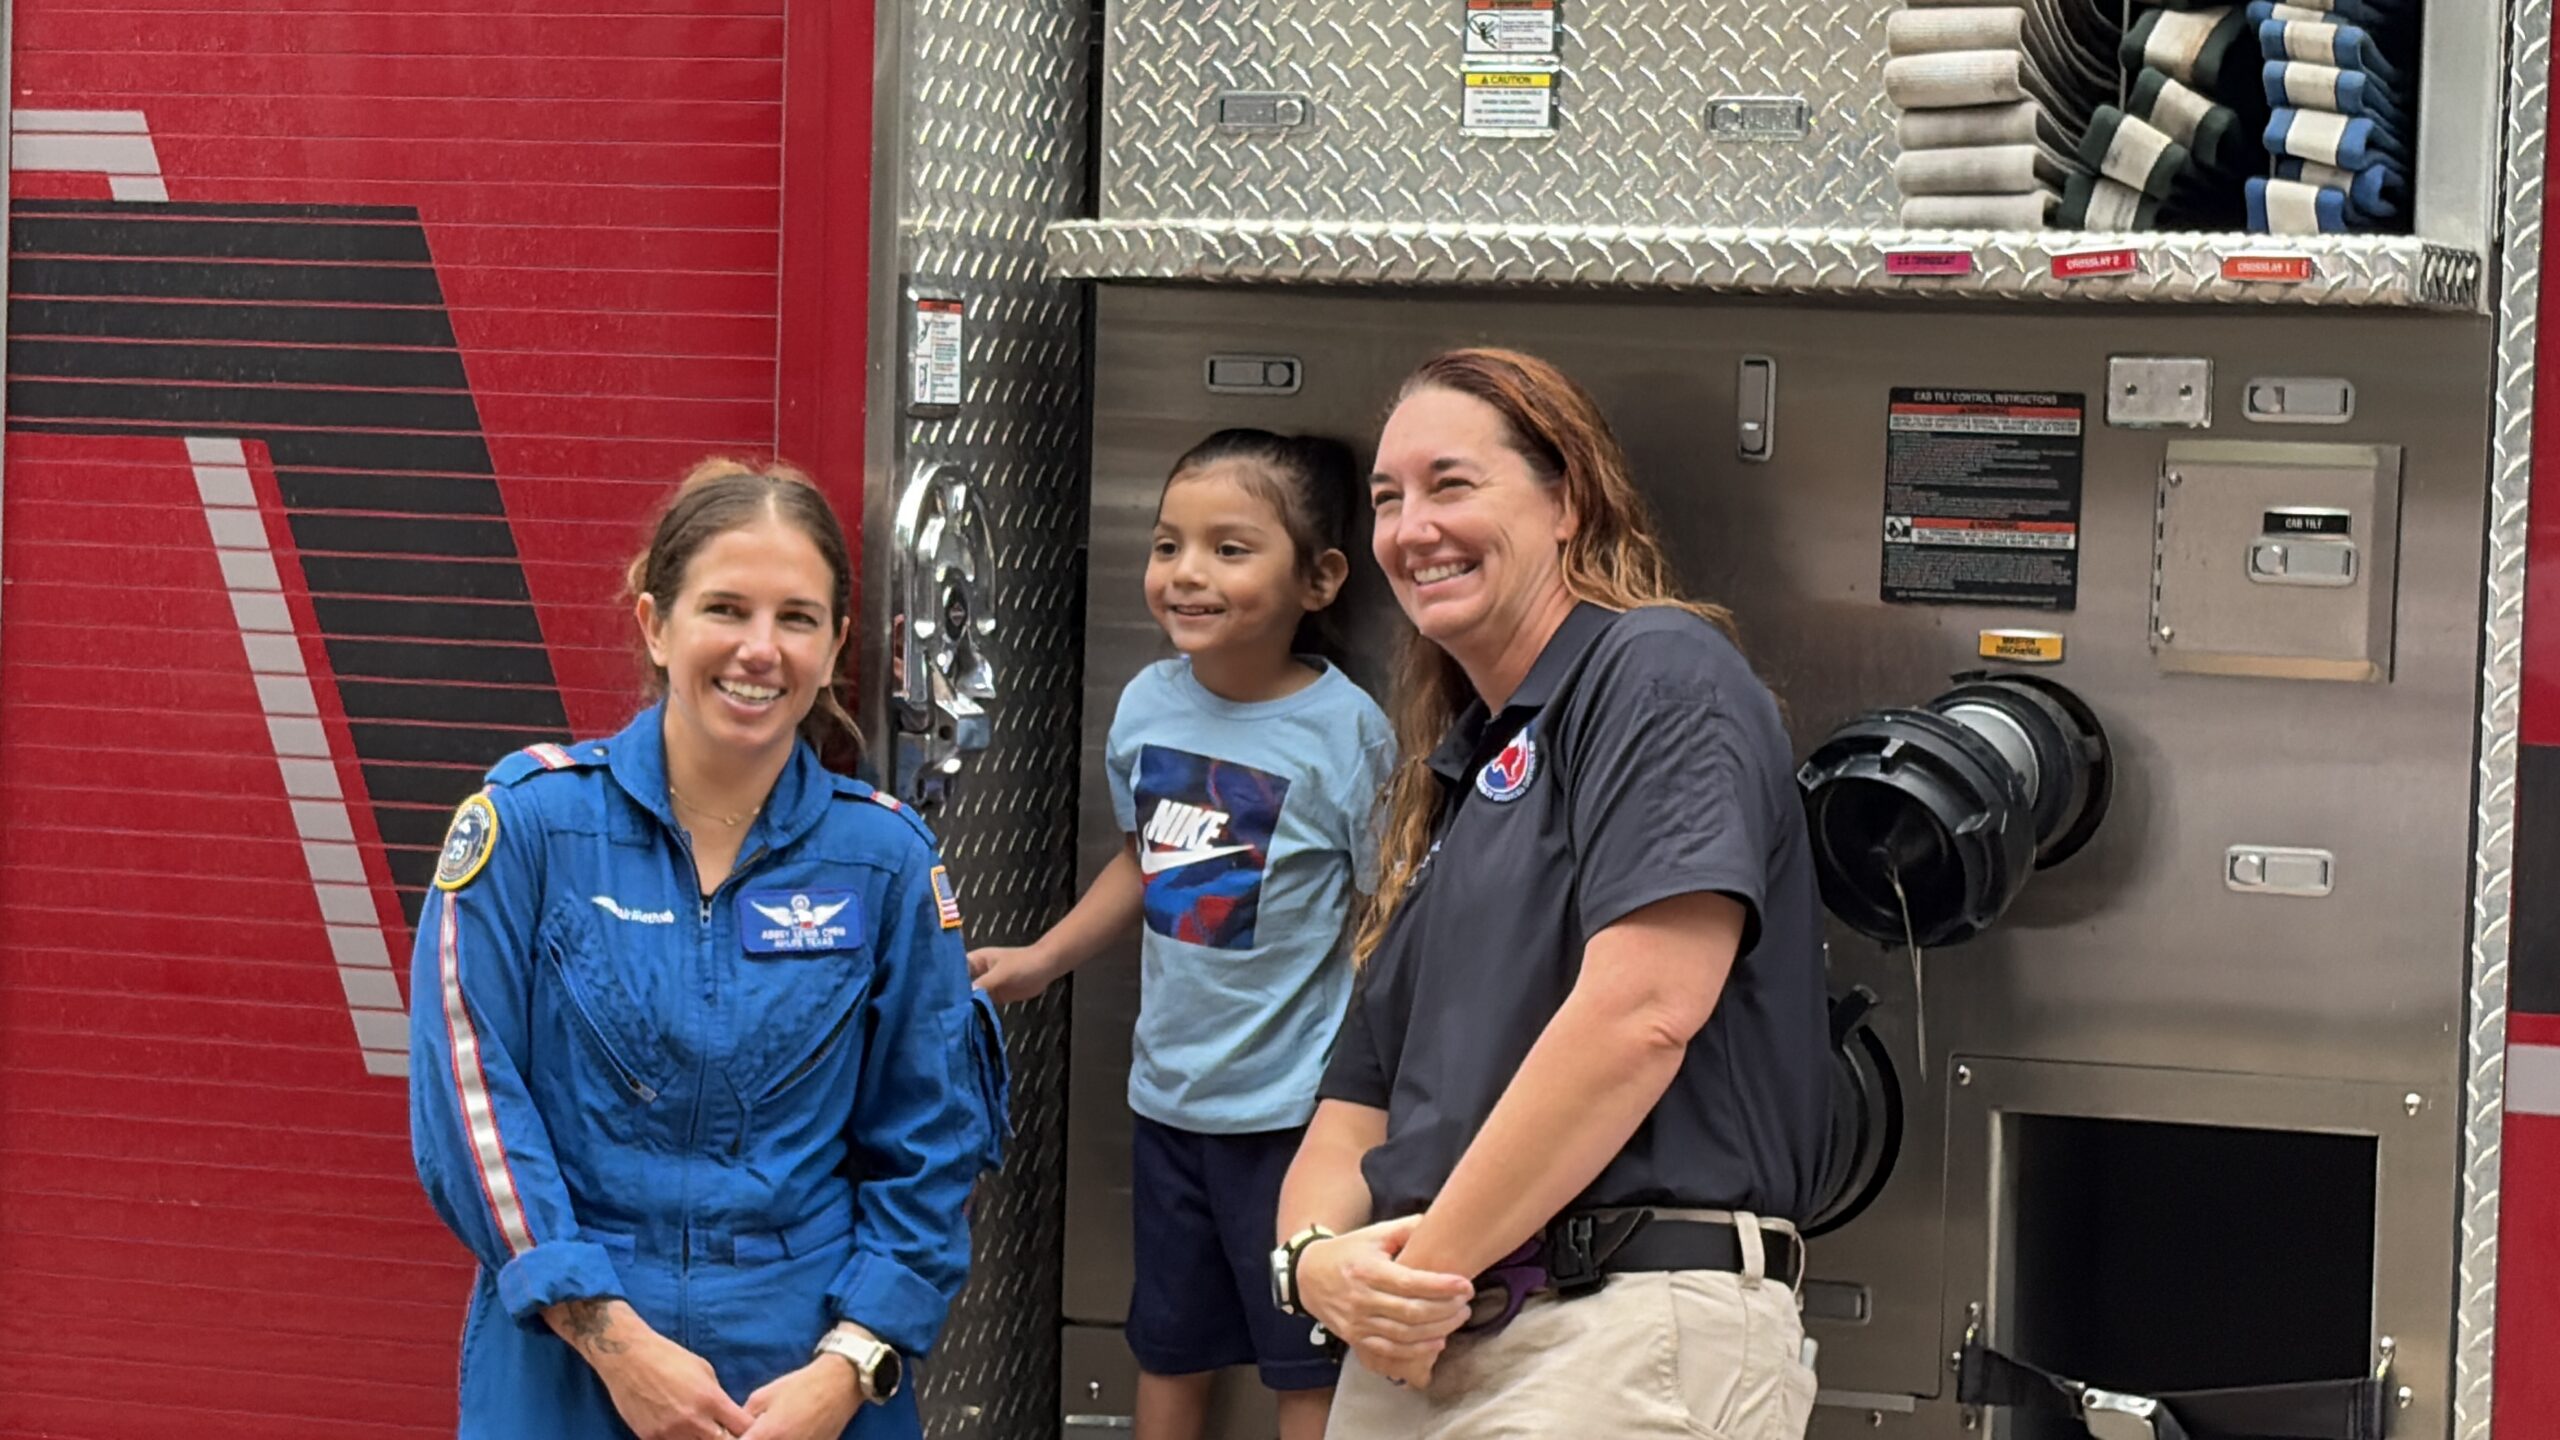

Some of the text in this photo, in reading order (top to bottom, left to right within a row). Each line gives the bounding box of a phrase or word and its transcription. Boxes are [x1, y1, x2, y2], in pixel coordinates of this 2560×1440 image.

[1490, 75, 1531, 85] CAUTION
[1913, 391, 2058, 405] CAB TILT CONTROL INSTRUCTIONS
[2285, 518, 2323, 529] CAB TILT
[1996, 645, 2042, 655] DISCHARGE
[1148, 798, 1229, 850] NIKE
[805, 937, 834, 947] TEXAS
